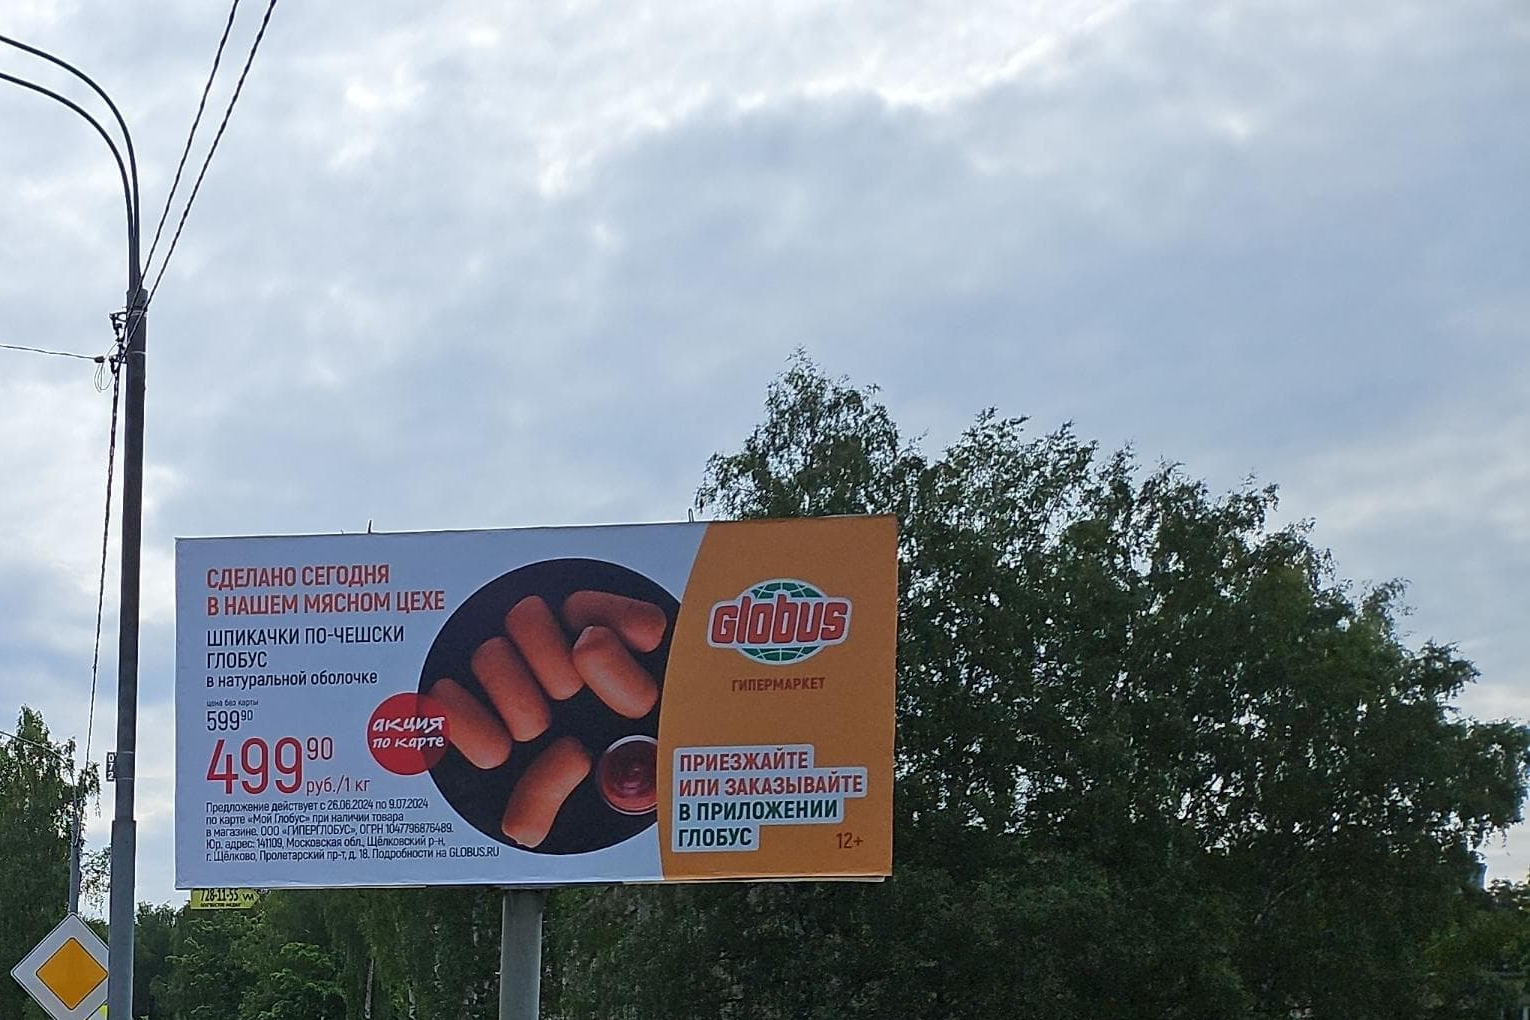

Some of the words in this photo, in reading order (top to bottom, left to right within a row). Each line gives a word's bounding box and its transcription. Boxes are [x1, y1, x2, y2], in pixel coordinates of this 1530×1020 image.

[207, 566, 296, 590] СДЕЛАНО
[302, 564, 389, 587] СЕГОДНЯ
[207, 597, 219, 616] В
[224, 594, 299, 615] НАШЕМ
[304, 592, 391, 614] МЯСНОМ
[396, 590, 445, 613] ЦЕХЕ
[207, 628, 299, 647] ШПИКАЧКИ
[305, 626, 405, 644] ПО-ЧЕШСКИ
[207, 652, 268, 669] ГЛОБУС
[206, 676, 215, 688] в
[218, 671, 307, 690] натуральной
[310, 670, 378, 686] оболочке
[731, 677, 826, 692] ГИПЕРМАРКЕТ
[372, 715, 447, 733] акция
[372, 737, 391, 749] по
[394, 736, 445, 750] карте
[679, 747, 809, 772] ПРИЕЗЖАЙТЕ
[355, 778, 371, 792] кг
[679, 778, 720, 797] ИЛИ
[724, 770, 864, 796] ЗАКАЗЫВАЙТЕ
[206, 801, 270, 815] Предложение
[271, 800, 318, 813] действует
[319, 802, 327, 811] с
[327, 799, 374, 811] 26.06.2024
[375, 800, 387, 810] по
[388, 798, 429, 809] 9.07.2024
[678, 803, 691, 821] В
[696, 800, 838, 821] ПРИЛОЖЕНИИ
[206, 816, 218, 826] по
[219, 815, 246, 828] карте
[248, 812, 272, 825] «Мой
[274, 812, 311, 826] Глобус»
[312, 814, 331, 825] при
[332, 812, 370, 823] наличии
[372, 812, 404, 824] товара
[206, 828, 212, 837] в
[260, 825, 280, 837] ООО
[359, 823, 384, 835] ОГРН
[678, 827, 753, 848] ГЛОБУС
[206, 839, 223, 851] Юр.
[286, 837, 343, 848] Московская
[366, 834, 426, 847] Щёлковский
[837, 832, 864, 849] 12+
[259, 849, 325, 862] Пролетарский
[372, 847, 434, 861] Подробности
[435, 848, 447, 858] на
[449, 846, 500, 858] GLOBUS.RU
